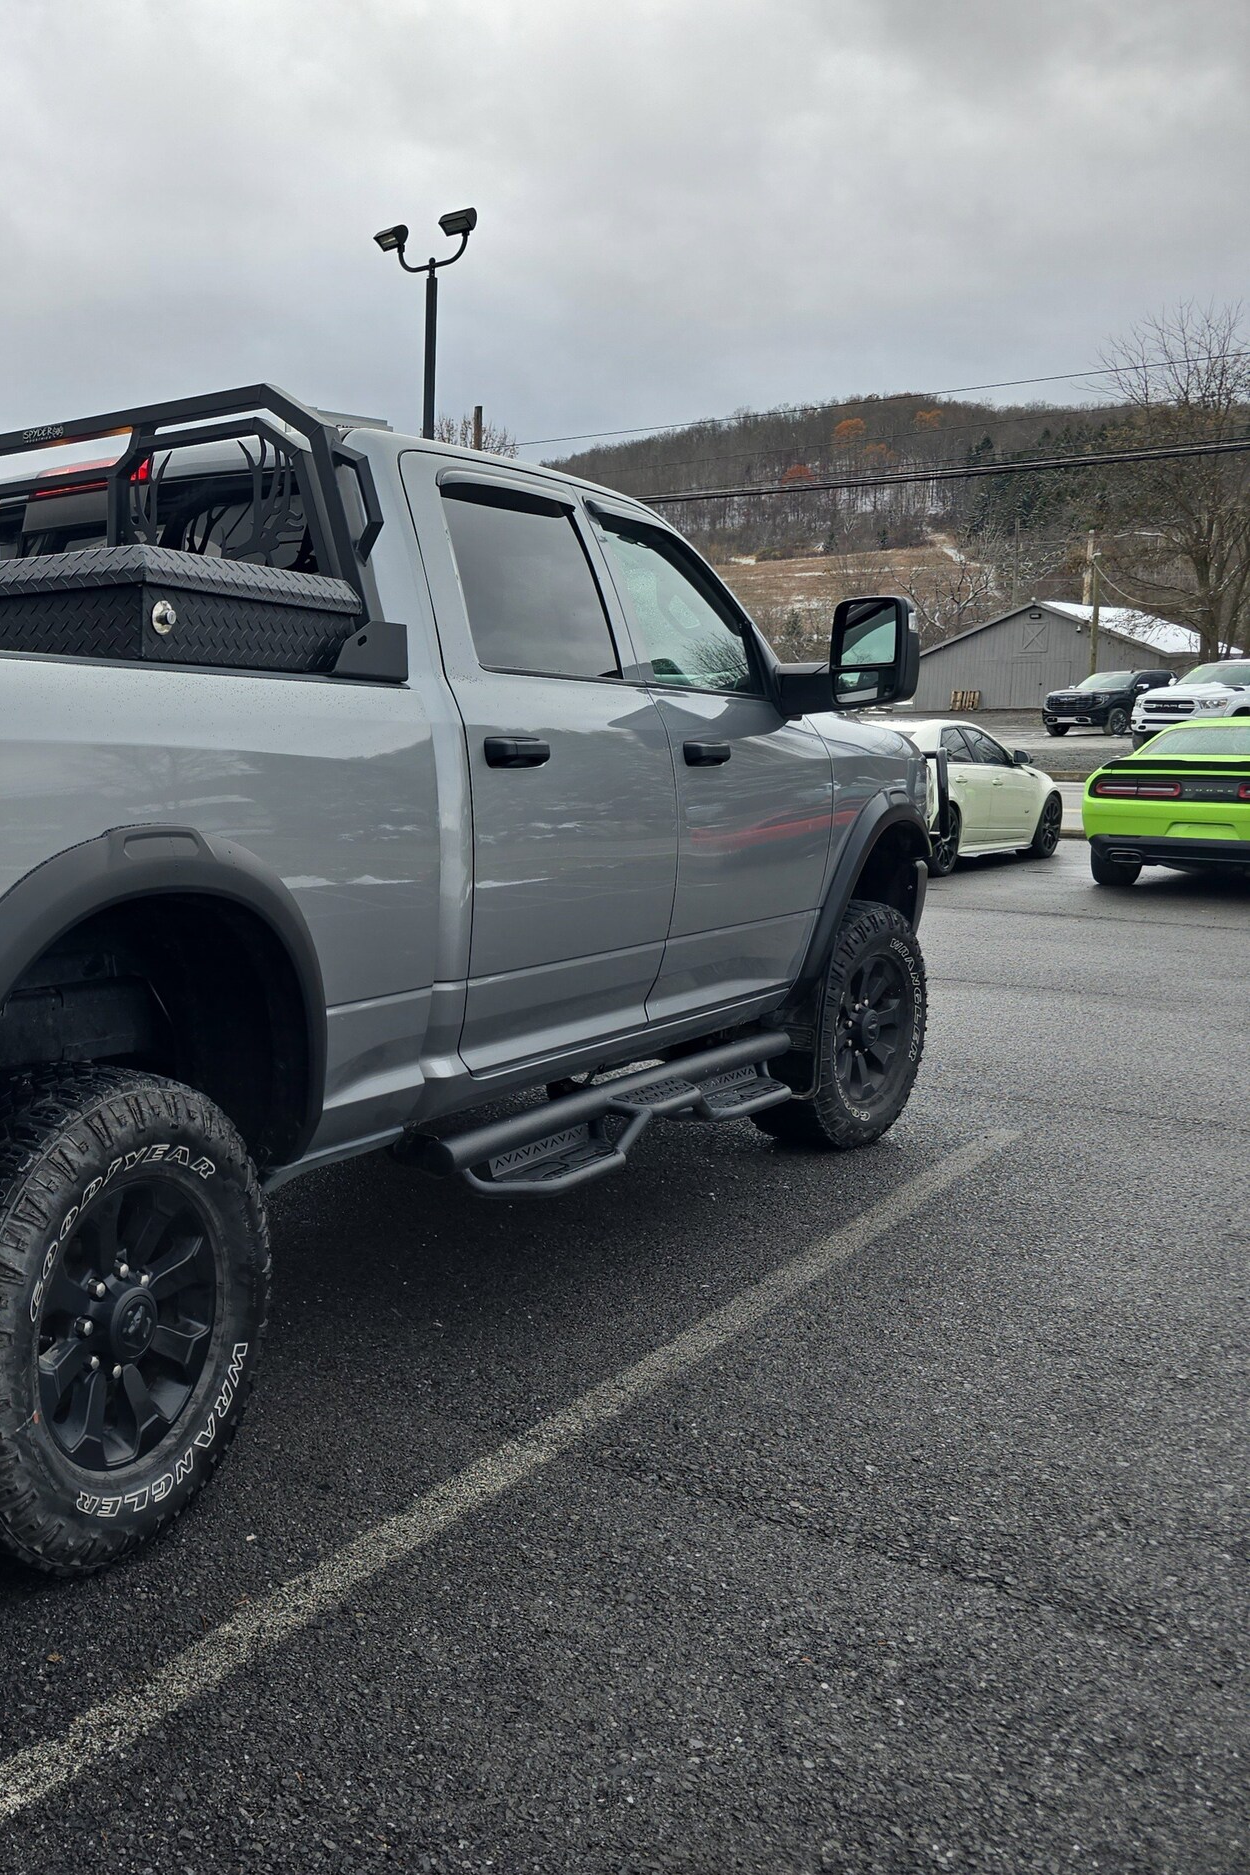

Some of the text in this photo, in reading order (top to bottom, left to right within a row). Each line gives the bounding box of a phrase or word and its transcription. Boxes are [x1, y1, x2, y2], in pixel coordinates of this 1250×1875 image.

[23, 427, 53, 440] SPYDER
[889, 938, 922, 1062] WRANGLER
[30, 1143, 216, 1322] GOODYEAR
[76, 1343, 248, 1518] WRANGLER
